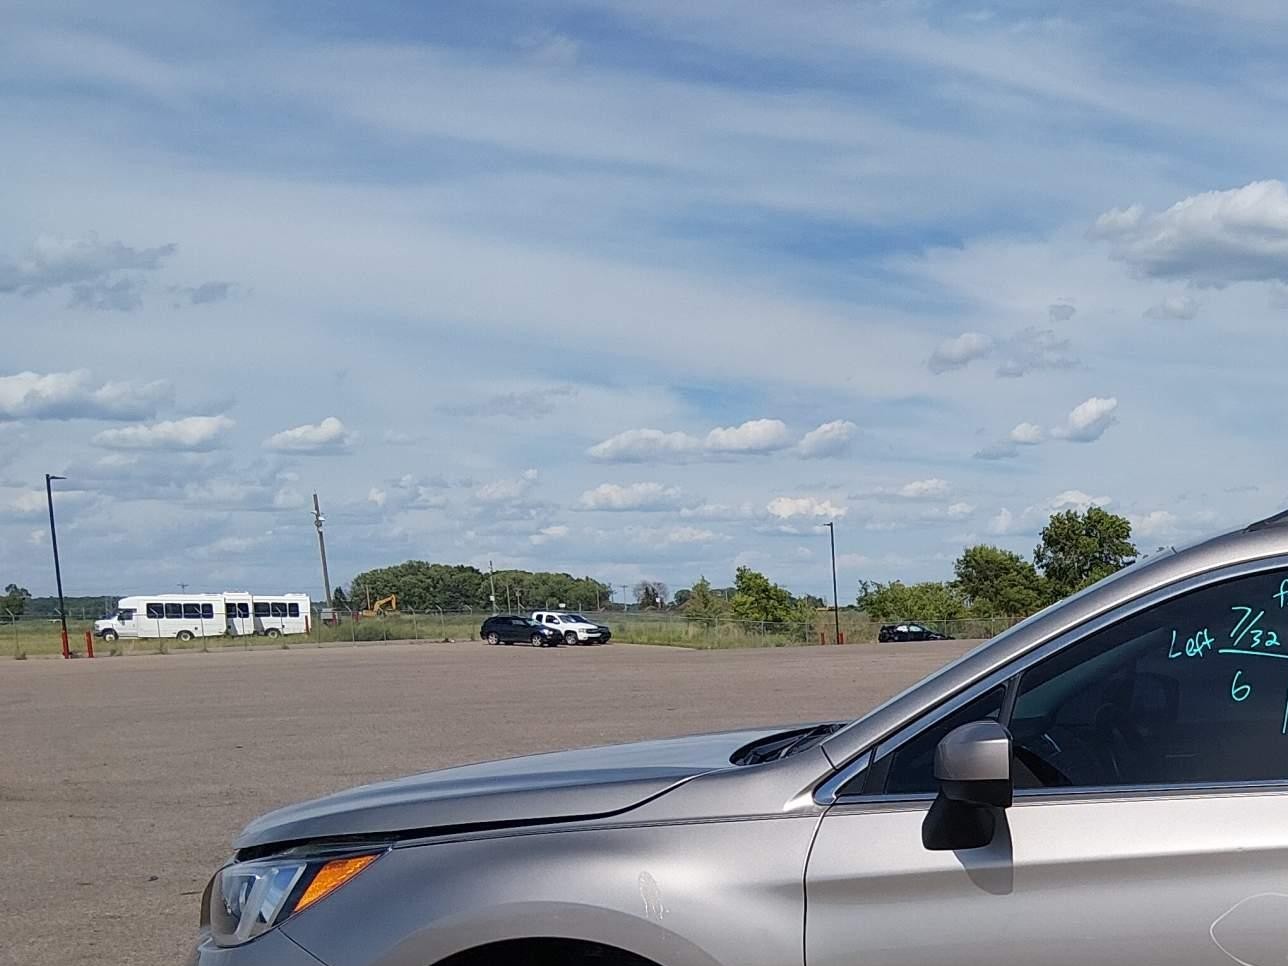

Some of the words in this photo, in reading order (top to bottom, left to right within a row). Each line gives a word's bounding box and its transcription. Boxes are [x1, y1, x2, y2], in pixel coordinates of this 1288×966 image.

[1168, 628, 1215, 660] Left
[1229, 606, 1281, 649] 7/32
[1231, 670, 1251, 701] 6
